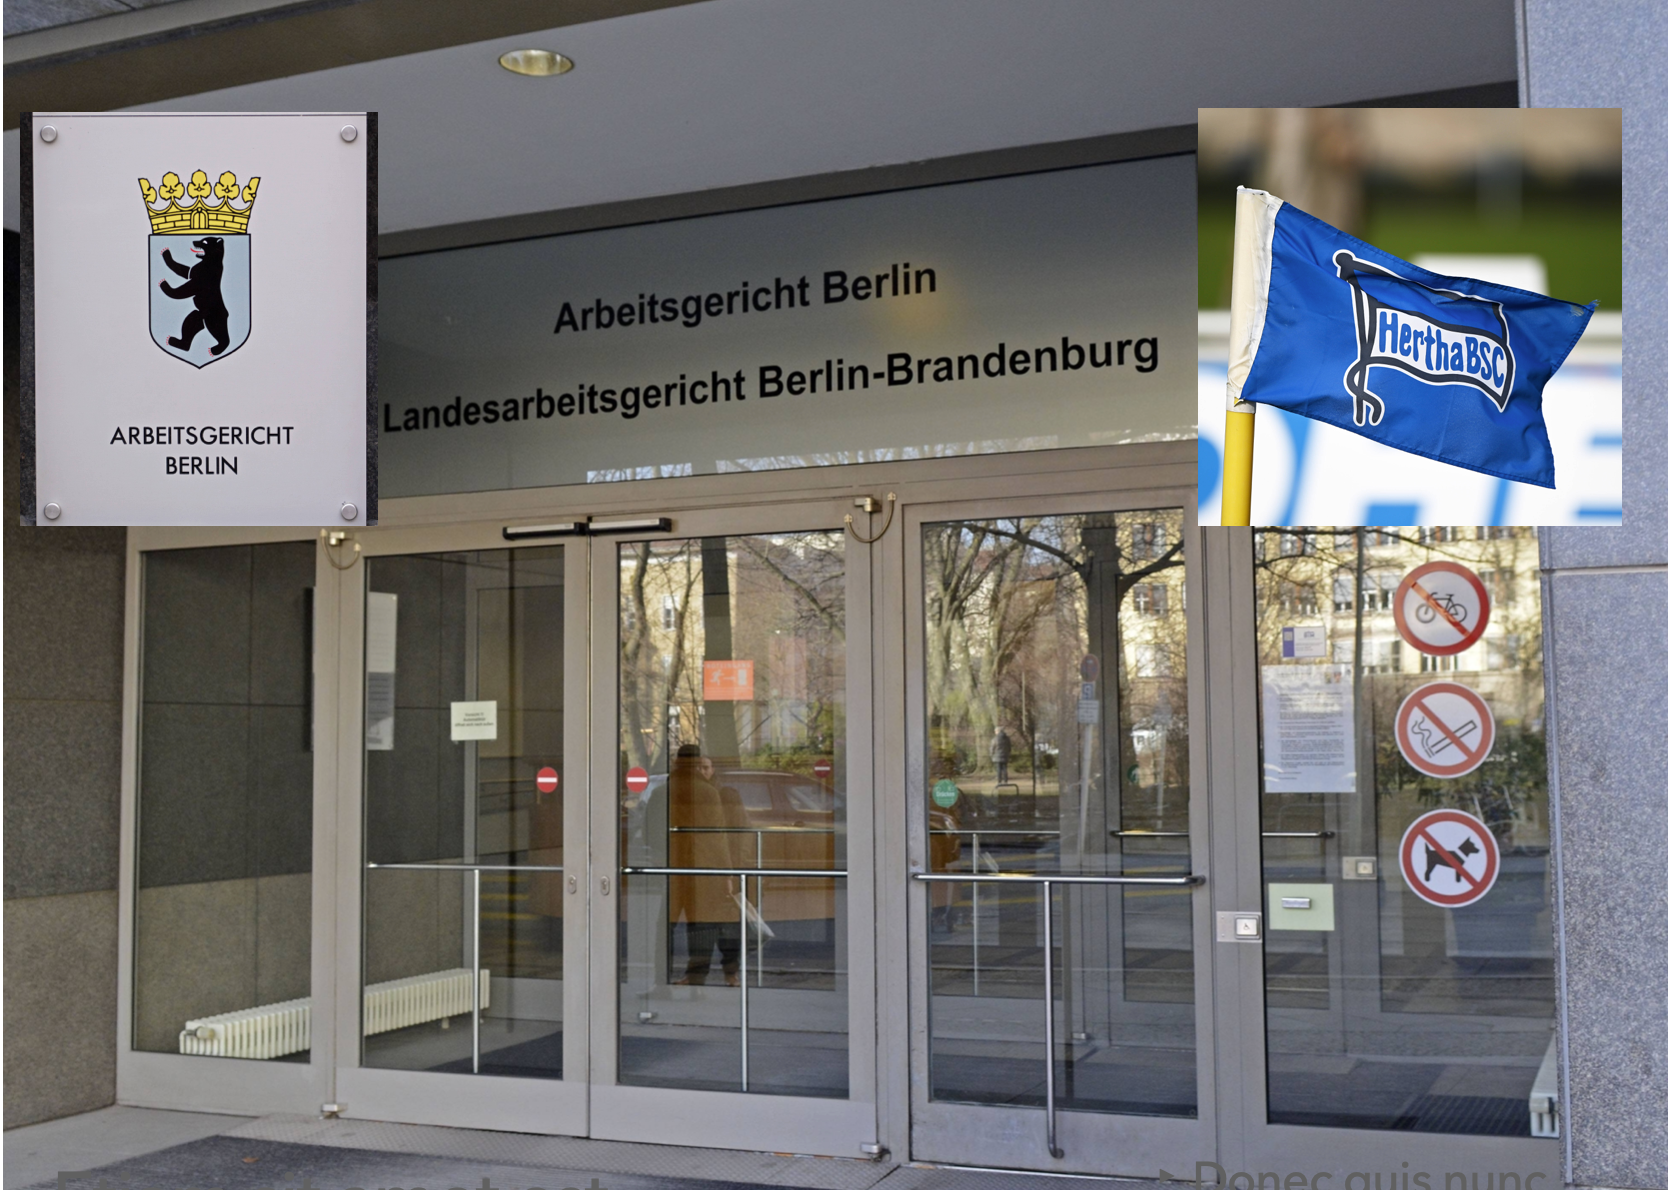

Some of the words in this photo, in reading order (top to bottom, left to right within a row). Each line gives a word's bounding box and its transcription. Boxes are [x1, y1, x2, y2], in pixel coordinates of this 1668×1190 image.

[553, 275, 811, 334] Arbeitsgericht
[822, 262, 937, 305] Berlin
[383, 368, 746, 433] Landesarbeitsgericht
[758, 335, 1159, 398] Berlin-Brandenburg
[110, 426, 294, 445] ARBEITSGERICHT
[165, 456, 238, 475] BERLIN
